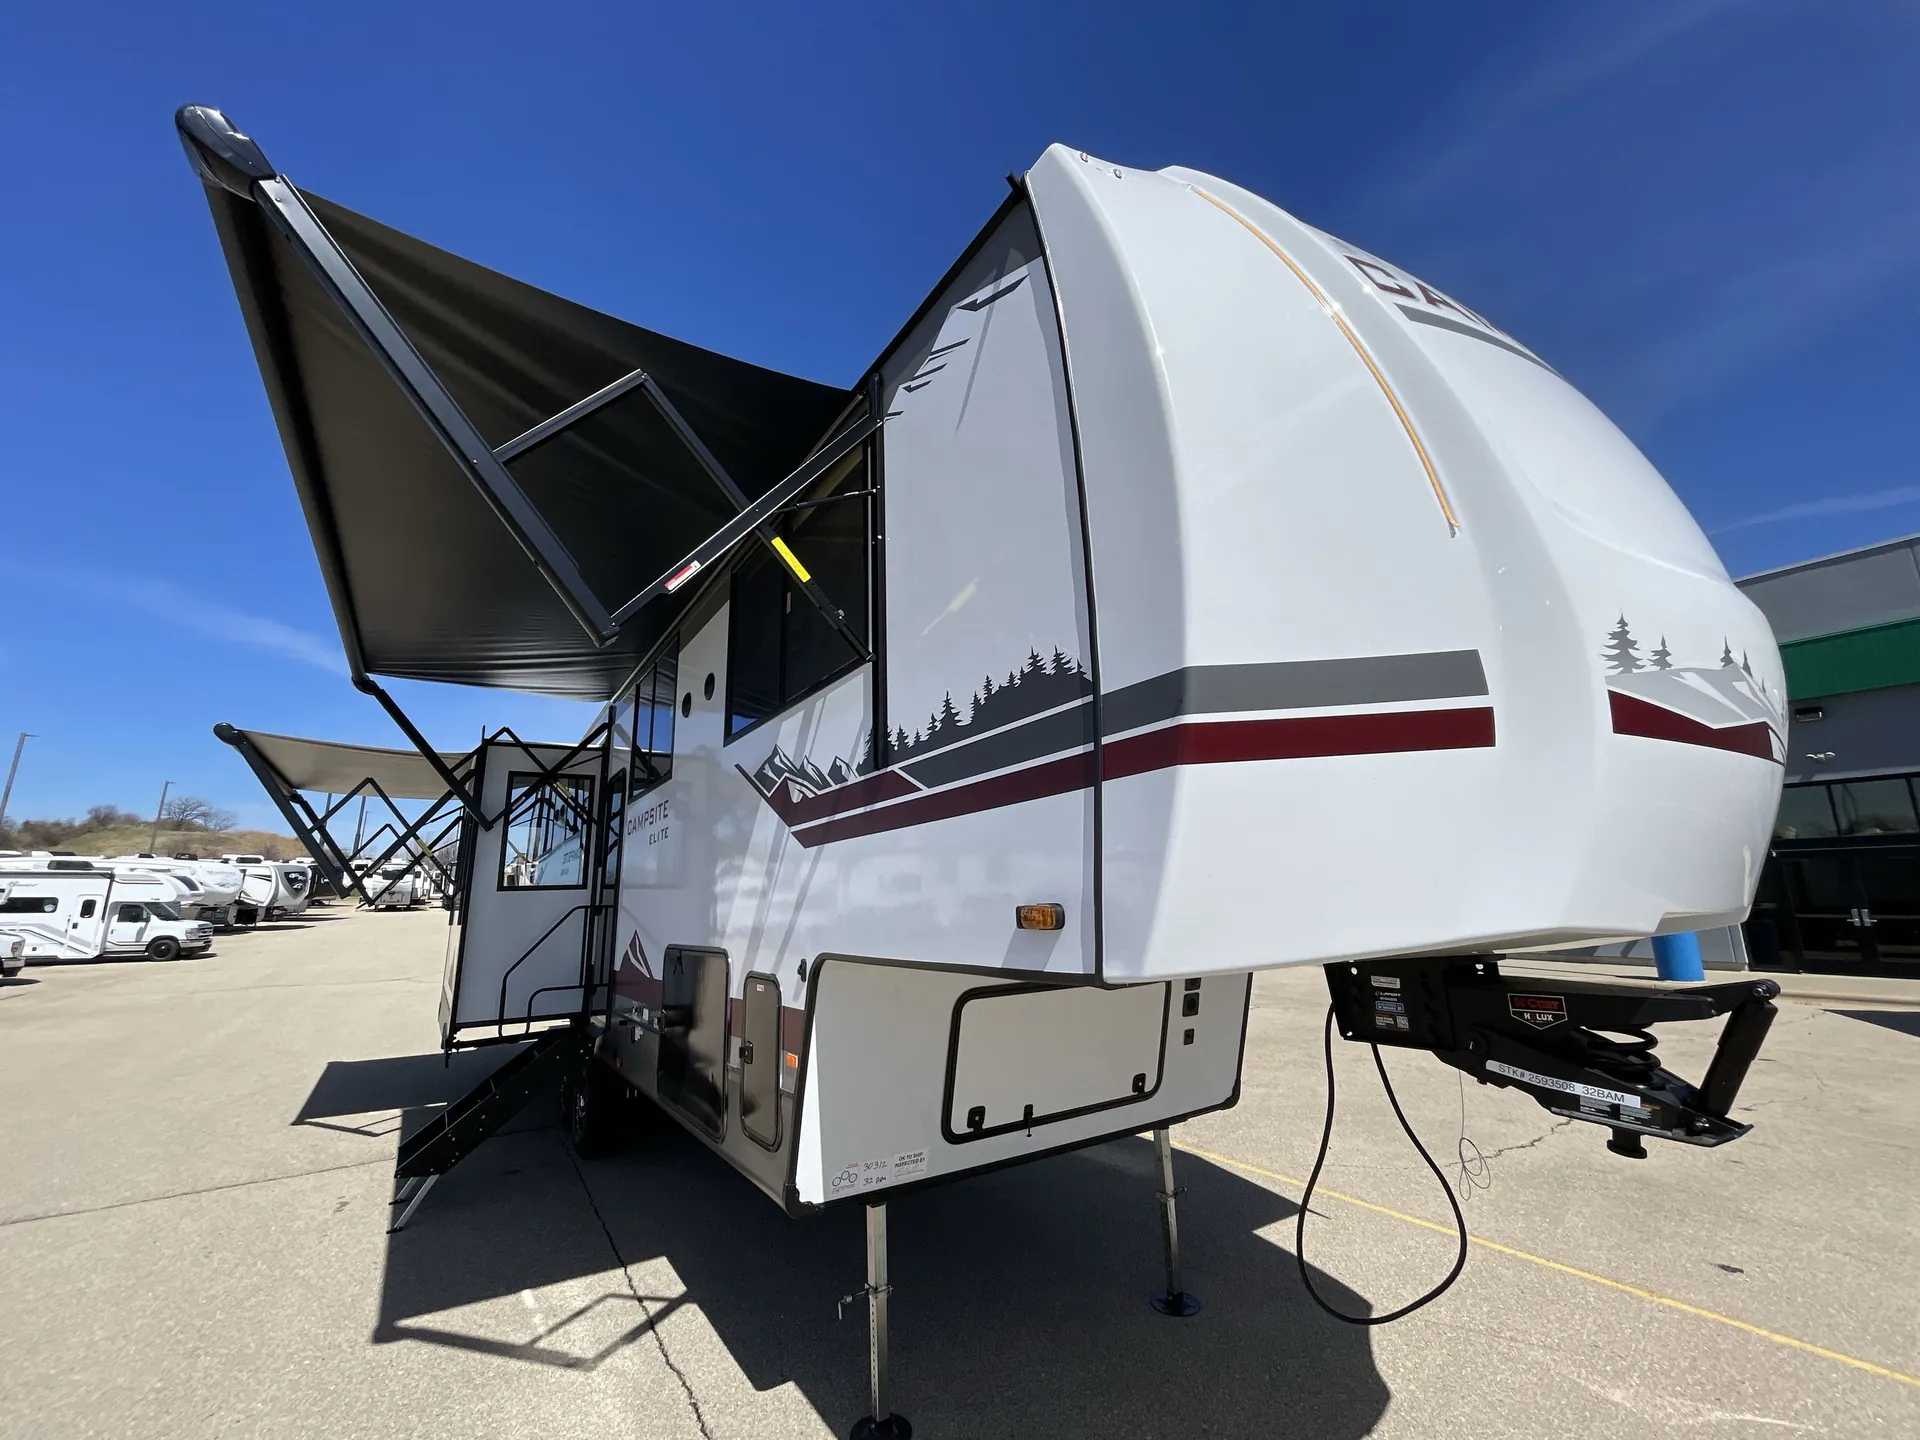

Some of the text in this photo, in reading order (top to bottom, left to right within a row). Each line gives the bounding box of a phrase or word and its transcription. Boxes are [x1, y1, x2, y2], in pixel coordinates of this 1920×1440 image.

[627, 799, 669, 835] CAMPSITE
[648, 827, 669, 845] ELITE
[1498, 1063, 1625, 1104] STK# 2593508 32BAM
[894, 1158, 919, 1168] INSPECTED
